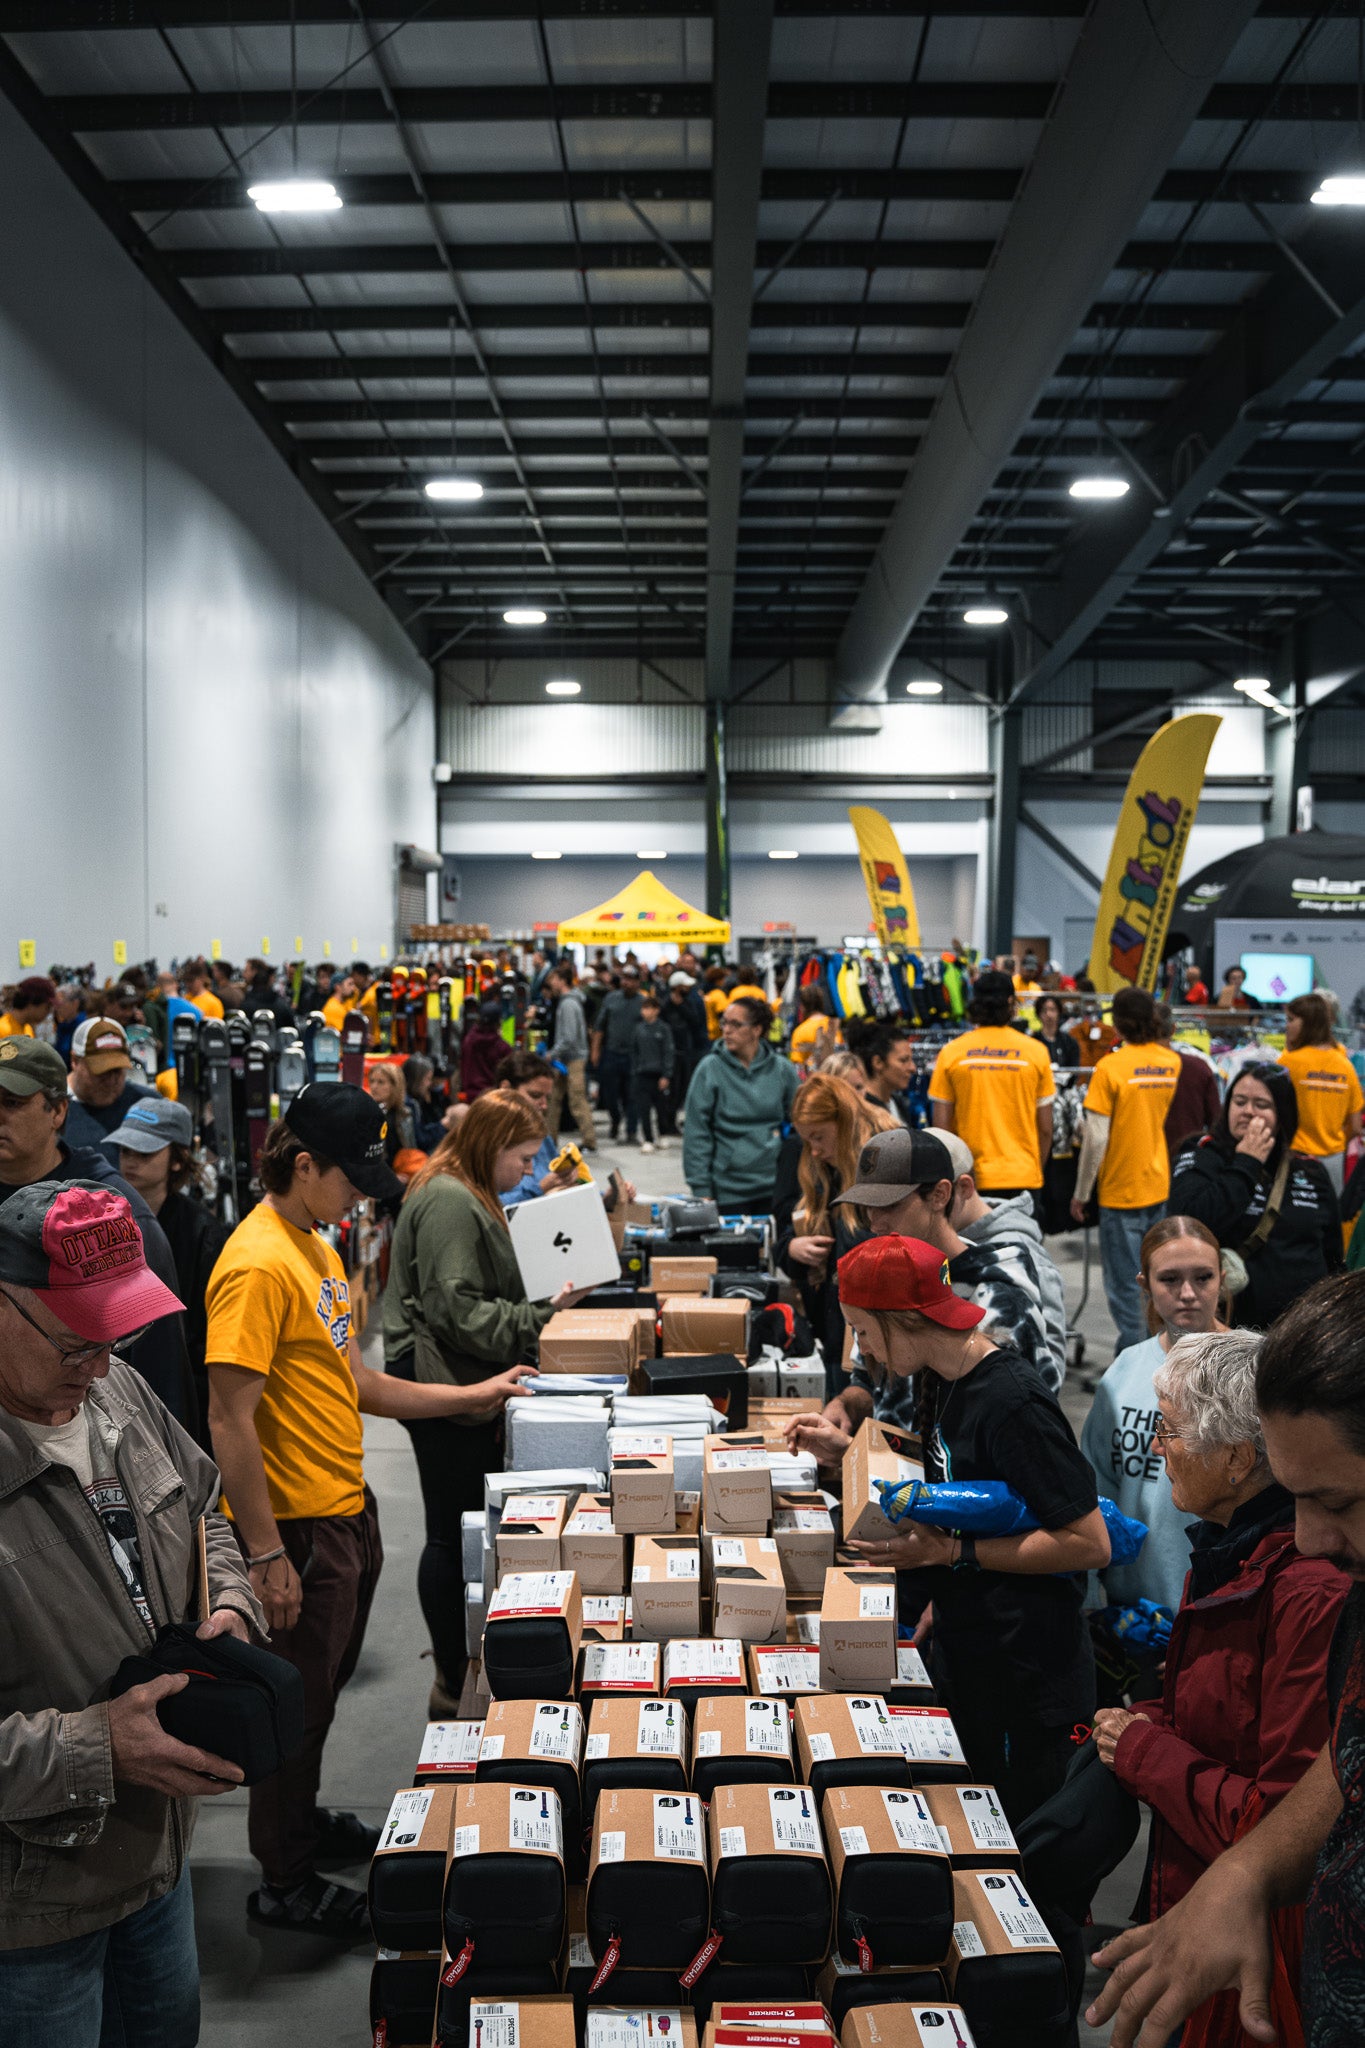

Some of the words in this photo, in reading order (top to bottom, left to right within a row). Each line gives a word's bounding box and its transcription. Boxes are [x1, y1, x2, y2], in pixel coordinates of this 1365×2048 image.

[61, 1216, 141, 1266] OTTAWA
[79, 1243, 142, 1278] REDBLACKS
[1112, 1428, 1157, 1457] COV
[629, 1494, 663, 1502] MARKER
[730, 1487, 766, 1495] MARKER
[656, 1600, 694, 1608] MARKER
[734, 1609, 772, 1617] MARKER
[847, 1641, 889, 1649] MARKER
[597, 1947, 618, 1983] MARKER
[690, 1942, 715, 1979] MARKER
[375, 2031, 383, 2048] KER
